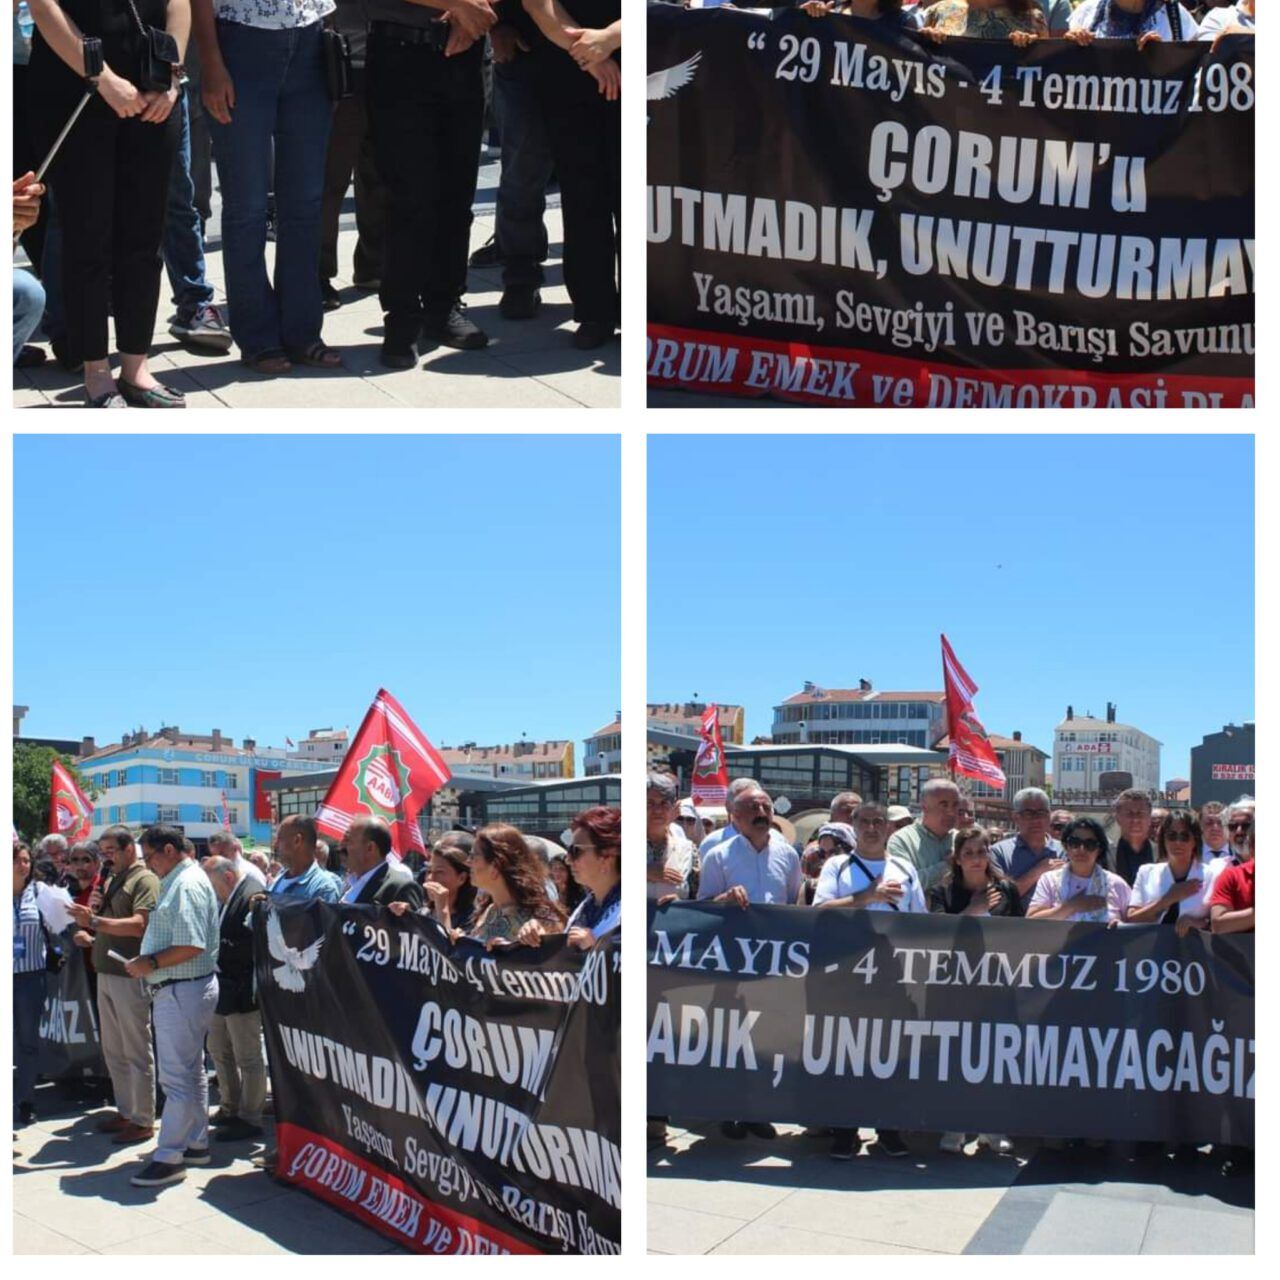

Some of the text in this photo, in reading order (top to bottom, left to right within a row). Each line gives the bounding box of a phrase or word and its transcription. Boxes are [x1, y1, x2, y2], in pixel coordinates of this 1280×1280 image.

[774, 33, 822, 84] 29
[830, 40, 947, 102] Mayıs
[979, 62, 1004, 107] 4
[1015, 64, 1183, 116] Temmuz
[691, 271, 827, 333] Yaşamı,
[835, 290, 956, 353] Sevgiyi
[964, 311, 1006, 348] ve
[1013, 309, 1121, 363] Barışı
[744, 353, 863, 402] EMEK
[871, 373, 916, 407] ve
[356, 924, 392, 969] 29
[648, 929, 812, 980] MAYIS
[852, 952, 880, 986] 4
[892, 947, 1099, 992] TEMMUZ
[1113, 957, 1207, 997] 1980
[647, 1000, 762, 1072] ADIK
[287, 1141, 367, 1201] ÇORUM
[363, 1177, 426, 1240] EMEK
[425, 1215, 454, 1251] ve
